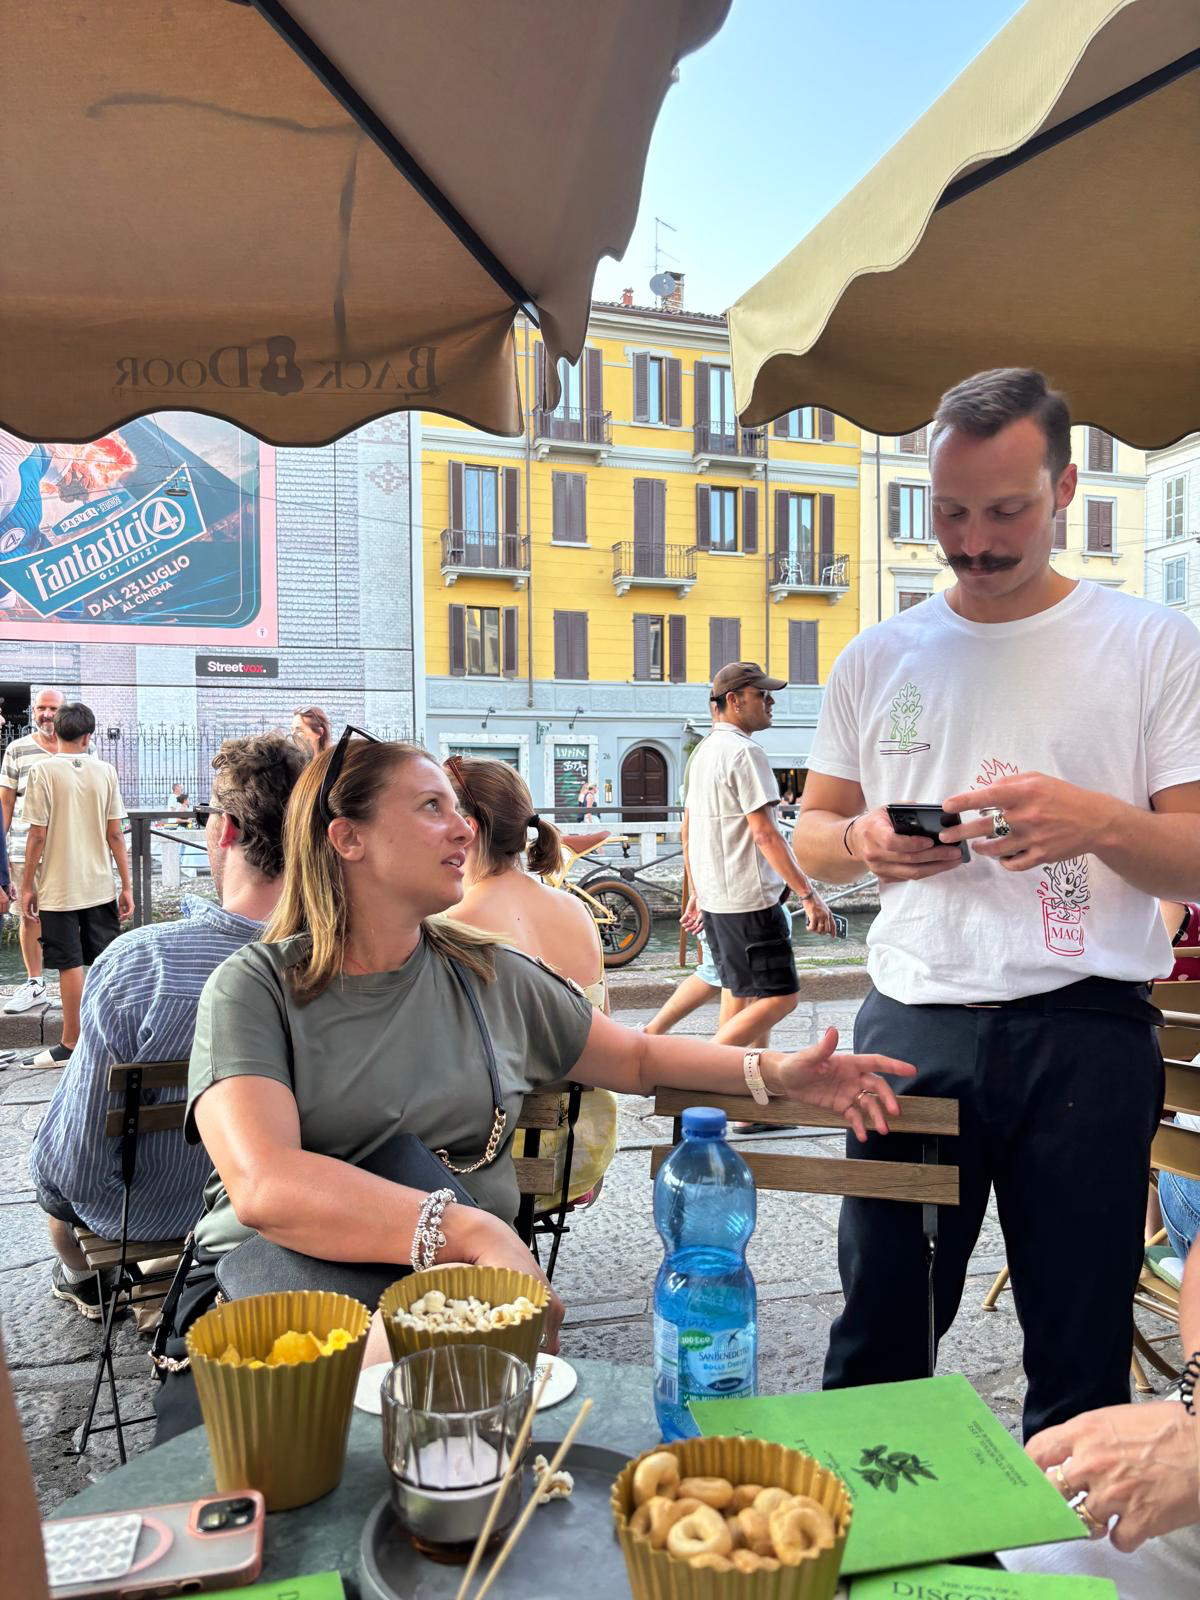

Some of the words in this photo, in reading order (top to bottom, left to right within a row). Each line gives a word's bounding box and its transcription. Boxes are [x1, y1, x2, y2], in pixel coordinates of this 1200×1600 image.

[61, 508, 98, 530] MARVEL
[29, 511, 149, 602] Fantastici
[149, 498, 181, 536] 4
[99, 565, 121, 582] GLI
[126, 544, 158, 567] INIZI
[87, 593, 122, 617] DAL
[120, 581, 141, 600] 23
[137, 555, 190, 591] LUGLIO
[121, 599, 137, 613] AL
[135, 581, 174, 605] CINEMA
